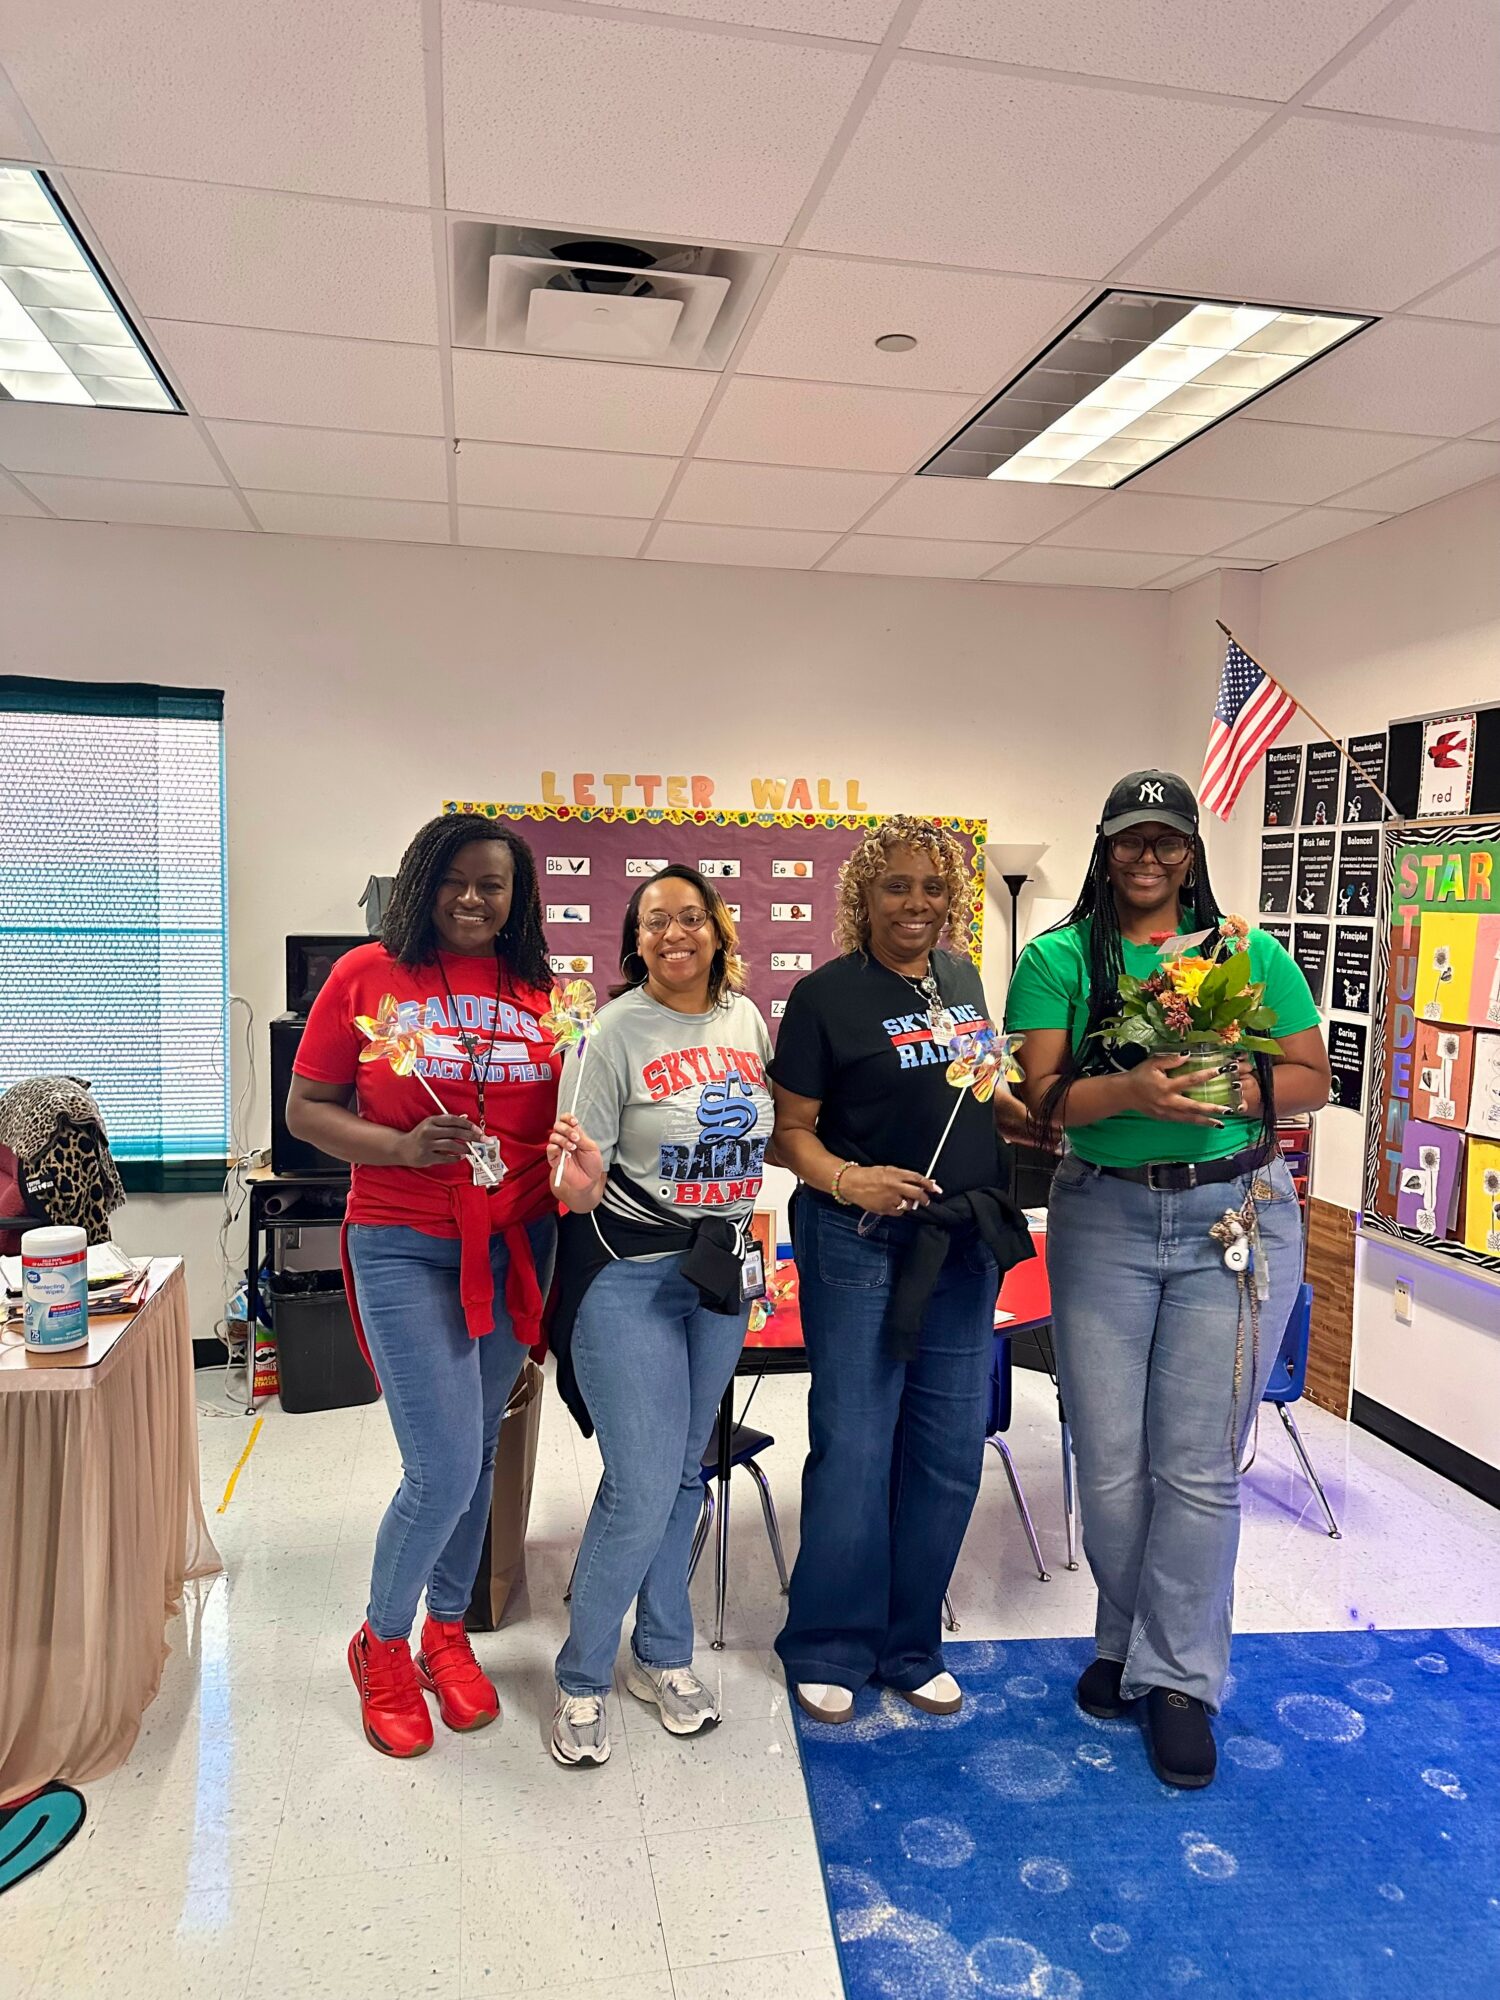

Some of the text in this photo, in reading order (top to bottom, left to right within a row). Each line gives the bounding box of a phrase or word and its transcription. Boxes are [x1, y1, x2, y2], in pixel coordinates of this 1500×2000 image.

[541, 771, 868, 811] LETTER WALL
[1432, 786, 1452, 803] red
[1303, 837, 1331, 847] Risk Taker
[1347, 836, 1373, 845] Balanced
[548, 859, 562, 871] Bb
[627, 862, 642, 873] Cc
[700, 862, 715, 874] Dd
[774, 863, 786, 874] Ee
[1398, 852, 1493, 902] STAR
[1303, 930, 1321, 939] Thinker
[1341, 931, 1368, 942] Principled
[551, 959, 564, 971] Pp
[772, 956, 785, 967] Ss
[773, 1003, 785, 1014] Zz
[397, 994, 543, 1043] RAIDERS
[1338, 1027, 1357, 1041] Caring
[406, 1058, 552, 1083] RACK AND FIELD
[673, 1177, 763, 1206] BAND
